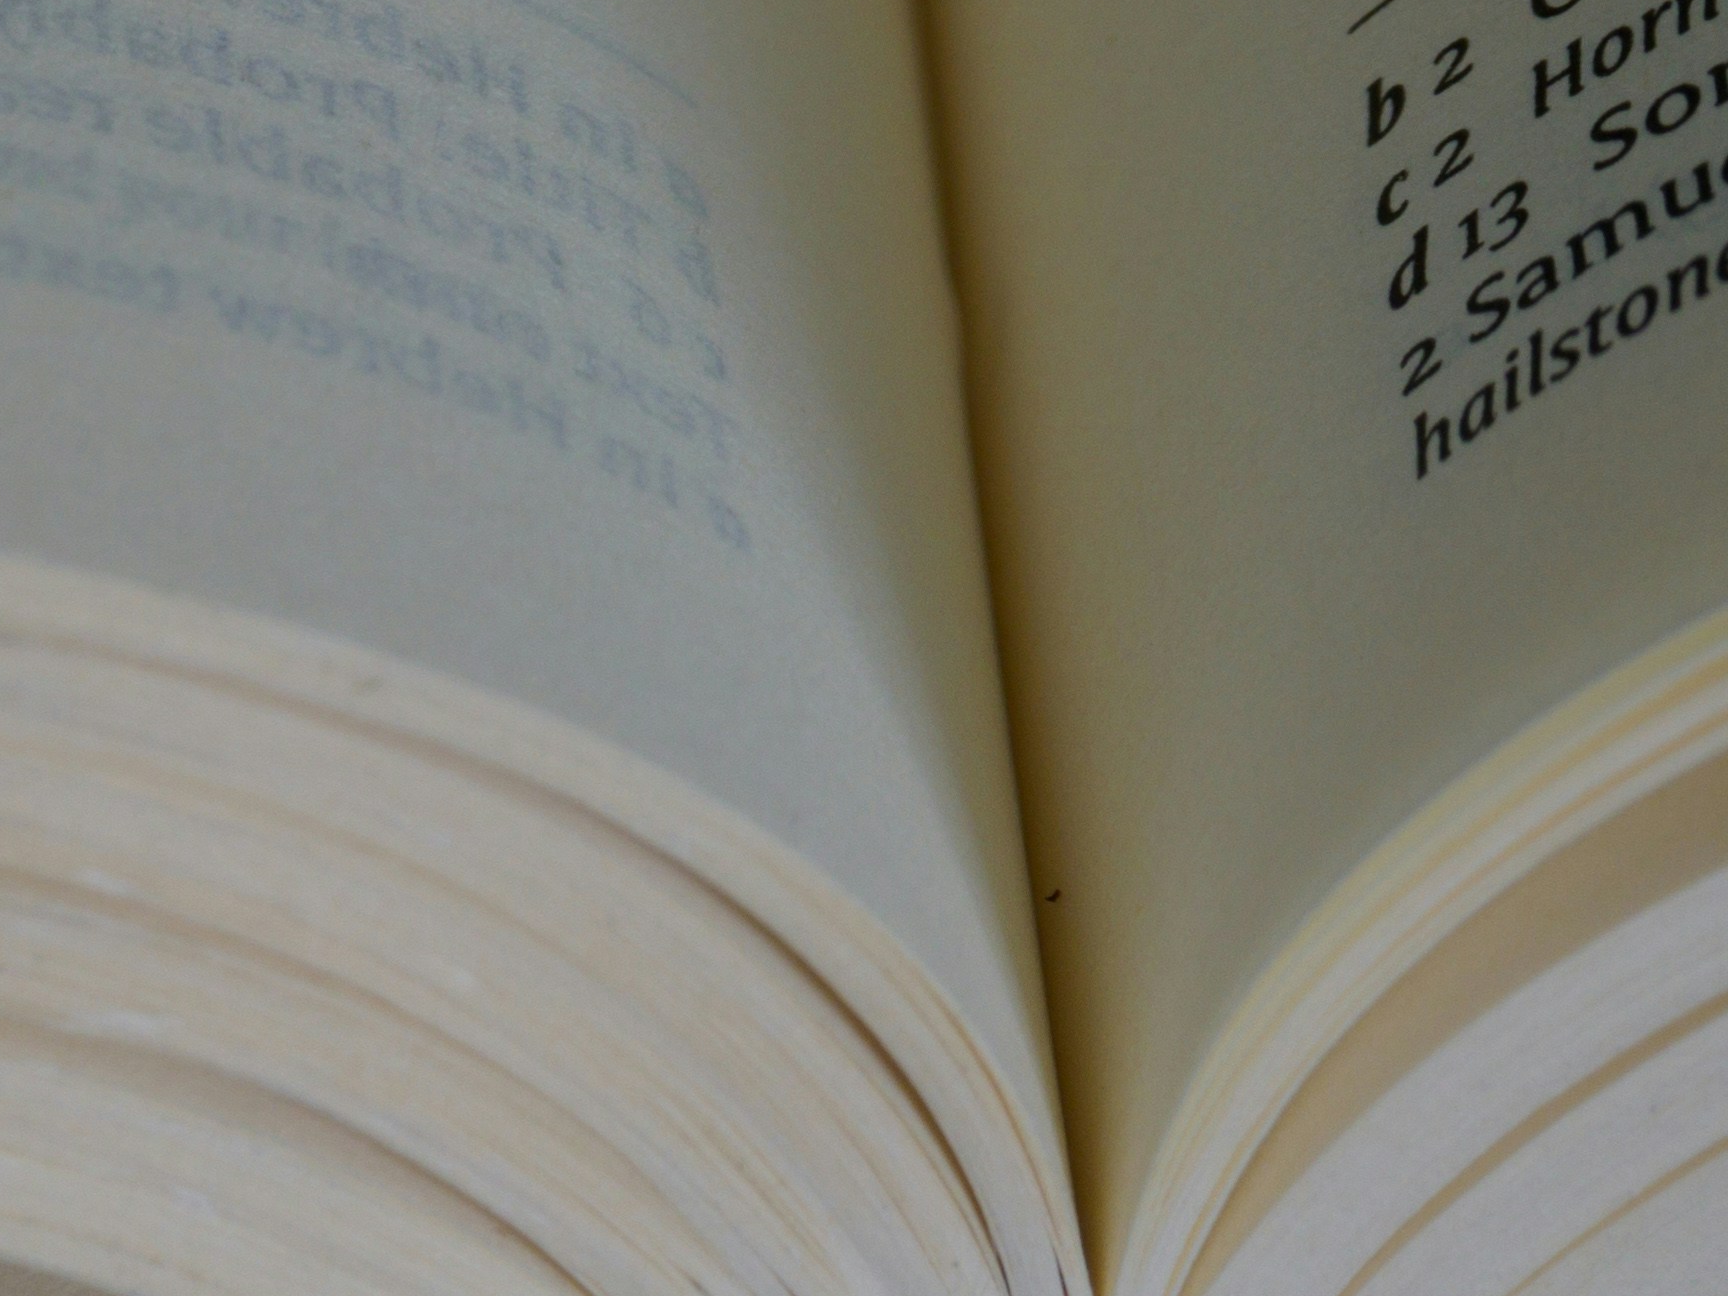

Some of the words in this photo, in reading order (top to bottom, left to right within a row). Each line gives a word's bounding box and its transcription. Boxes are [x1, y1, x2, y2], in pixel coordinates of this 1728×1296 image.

[1366, 76, 1407, 149] b
[1432, 36, 1474, 96] 2
[1375, 168, 1410, 228] c
[1432, 126, 1474, 190] 2
[1387, 225, 1430, 312] d
[1458, 180, 1530, 261] 13
[1400, 336, 1444, 398] 2
[1462, 159, 1728, 344] Samu
